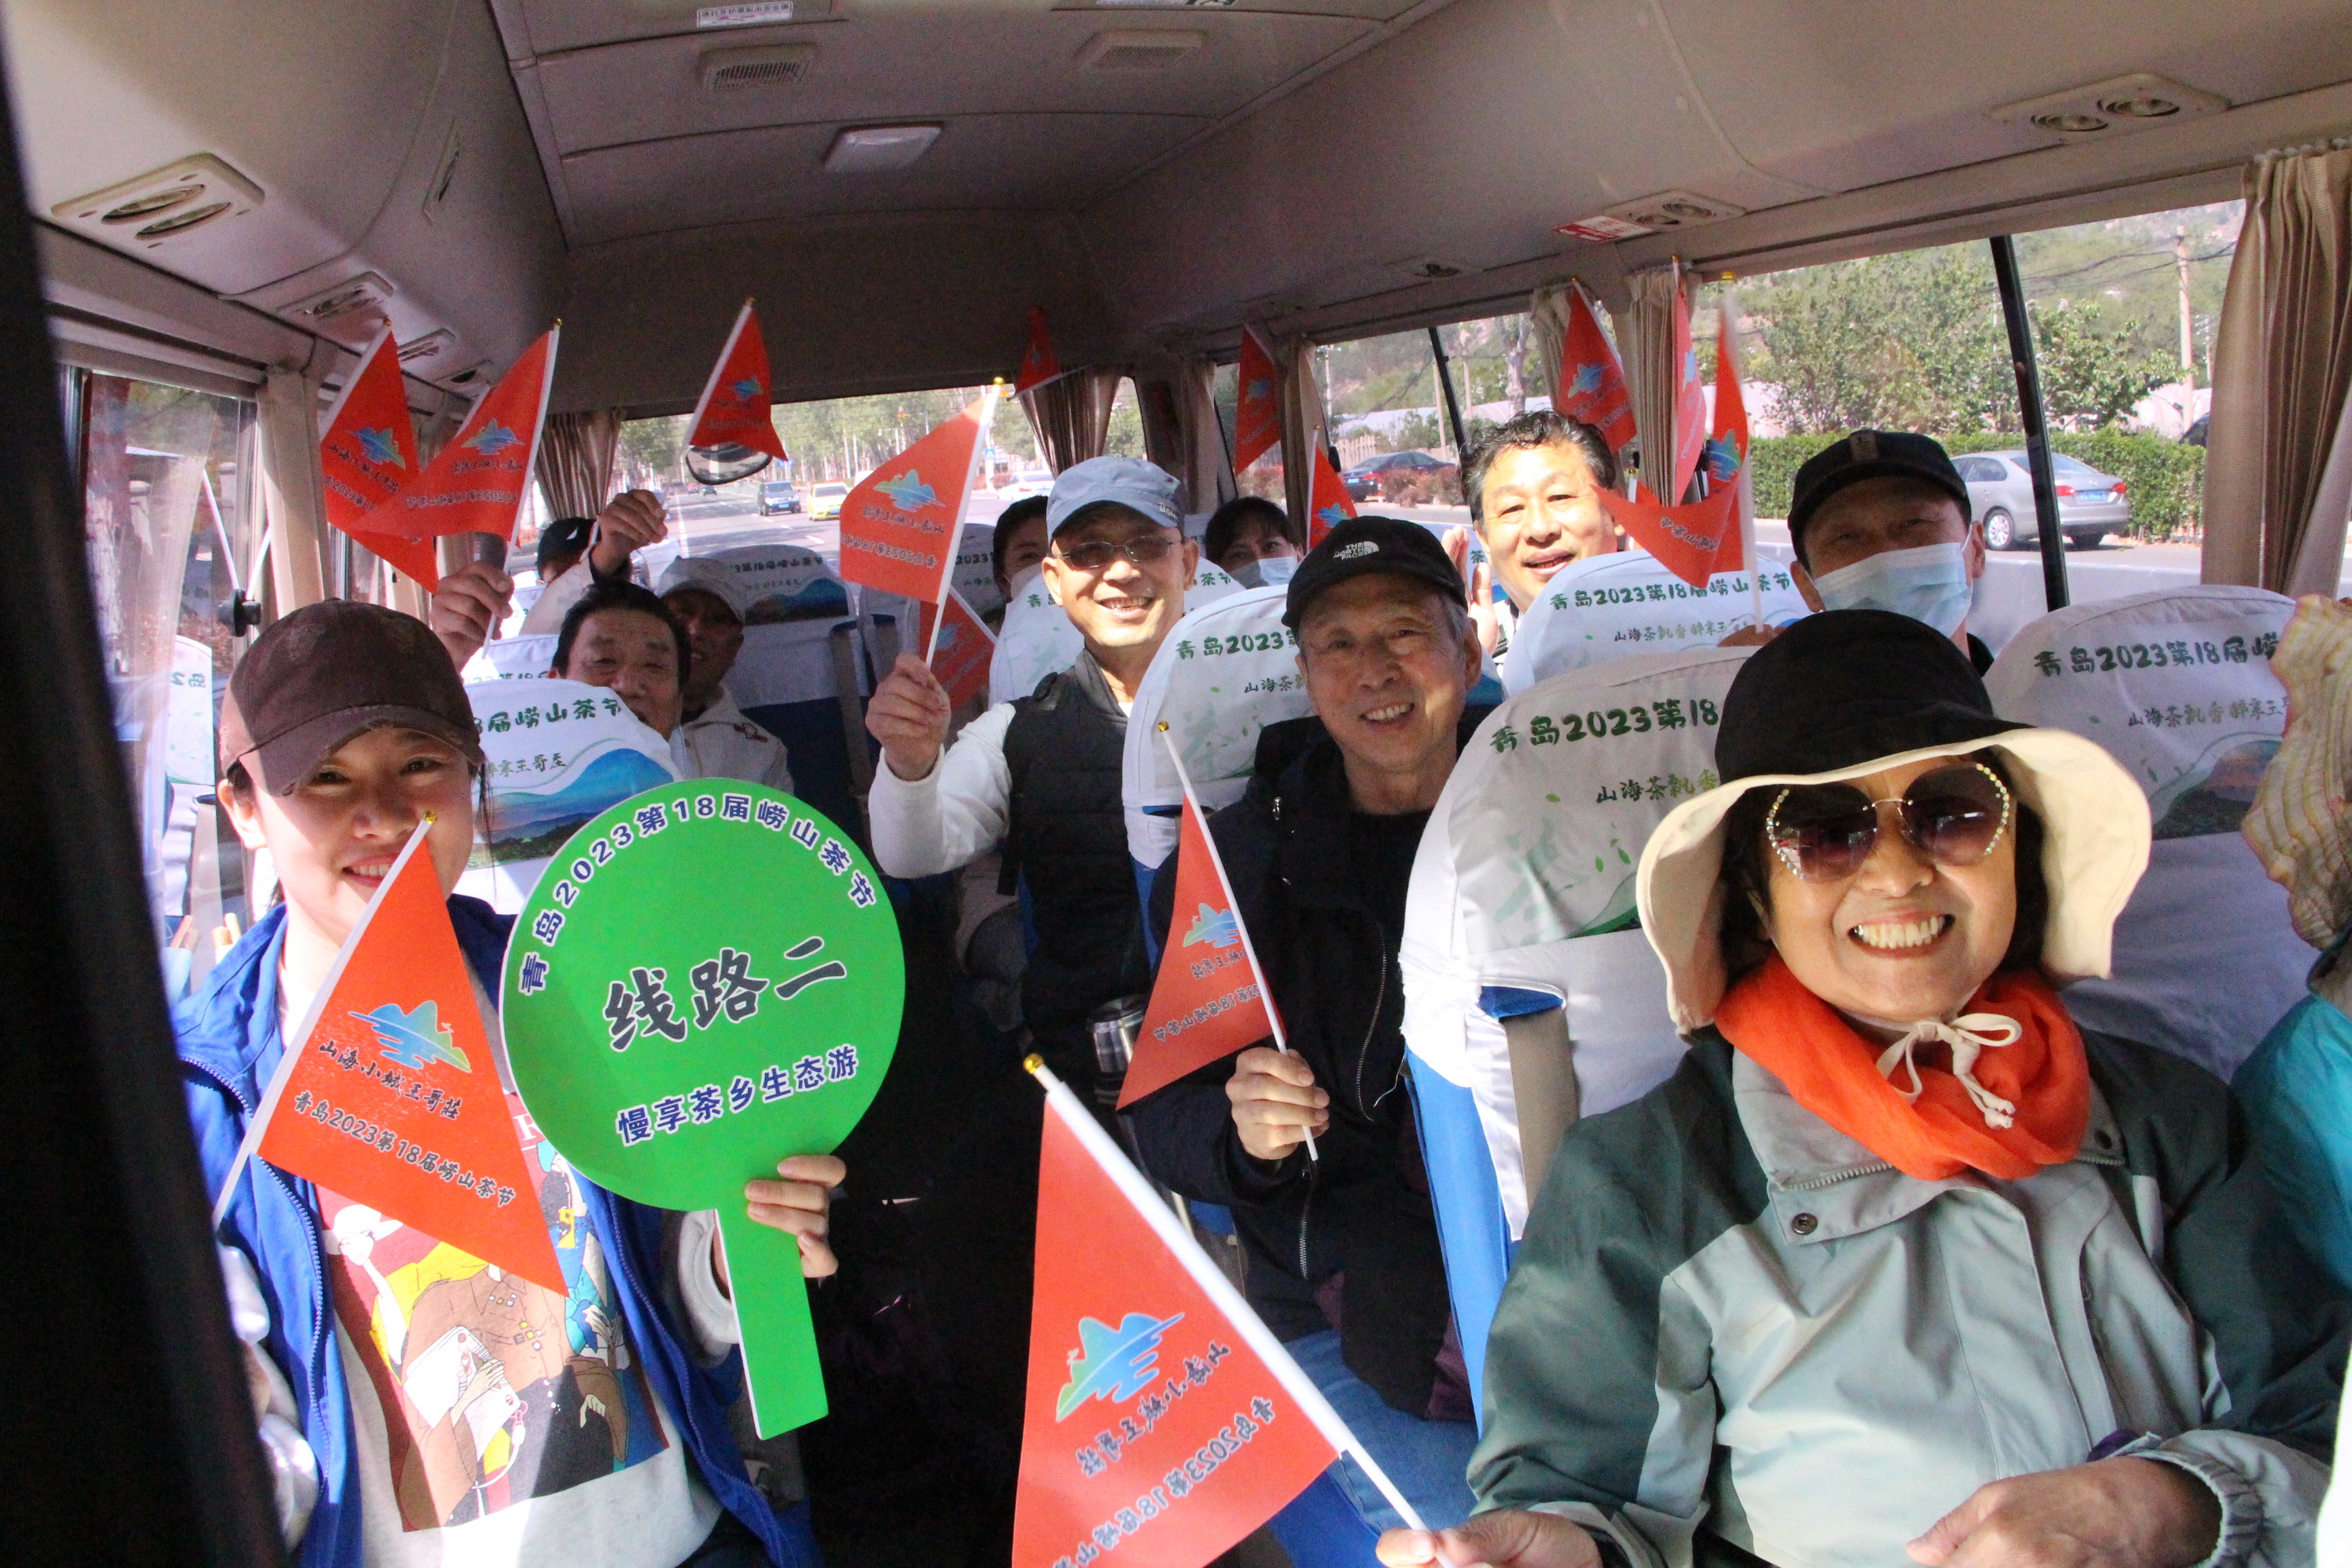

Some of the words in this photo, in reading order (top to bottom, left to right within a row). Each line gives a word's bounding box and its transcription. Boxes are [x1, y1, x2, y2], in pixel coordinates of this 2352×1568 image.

[955, 552, 994, 566] 2023
[1333, 547, 1364, 559] NORTH
[1345, 542, 1363, 550] THE
[1193, 572, 1231, 587] 茶节
[1489, 698, 1720, 753] 青岛2023第18
[519, 792, 877, 995] 青岛2023第18届崂山茶节
[603, 936, 847, 1051] 线路二
[616, 1044, 859, 1146] 慢享茶乡生态游
[294, 1090, 516, 1207] 青岛2023第18届崂山茶节
